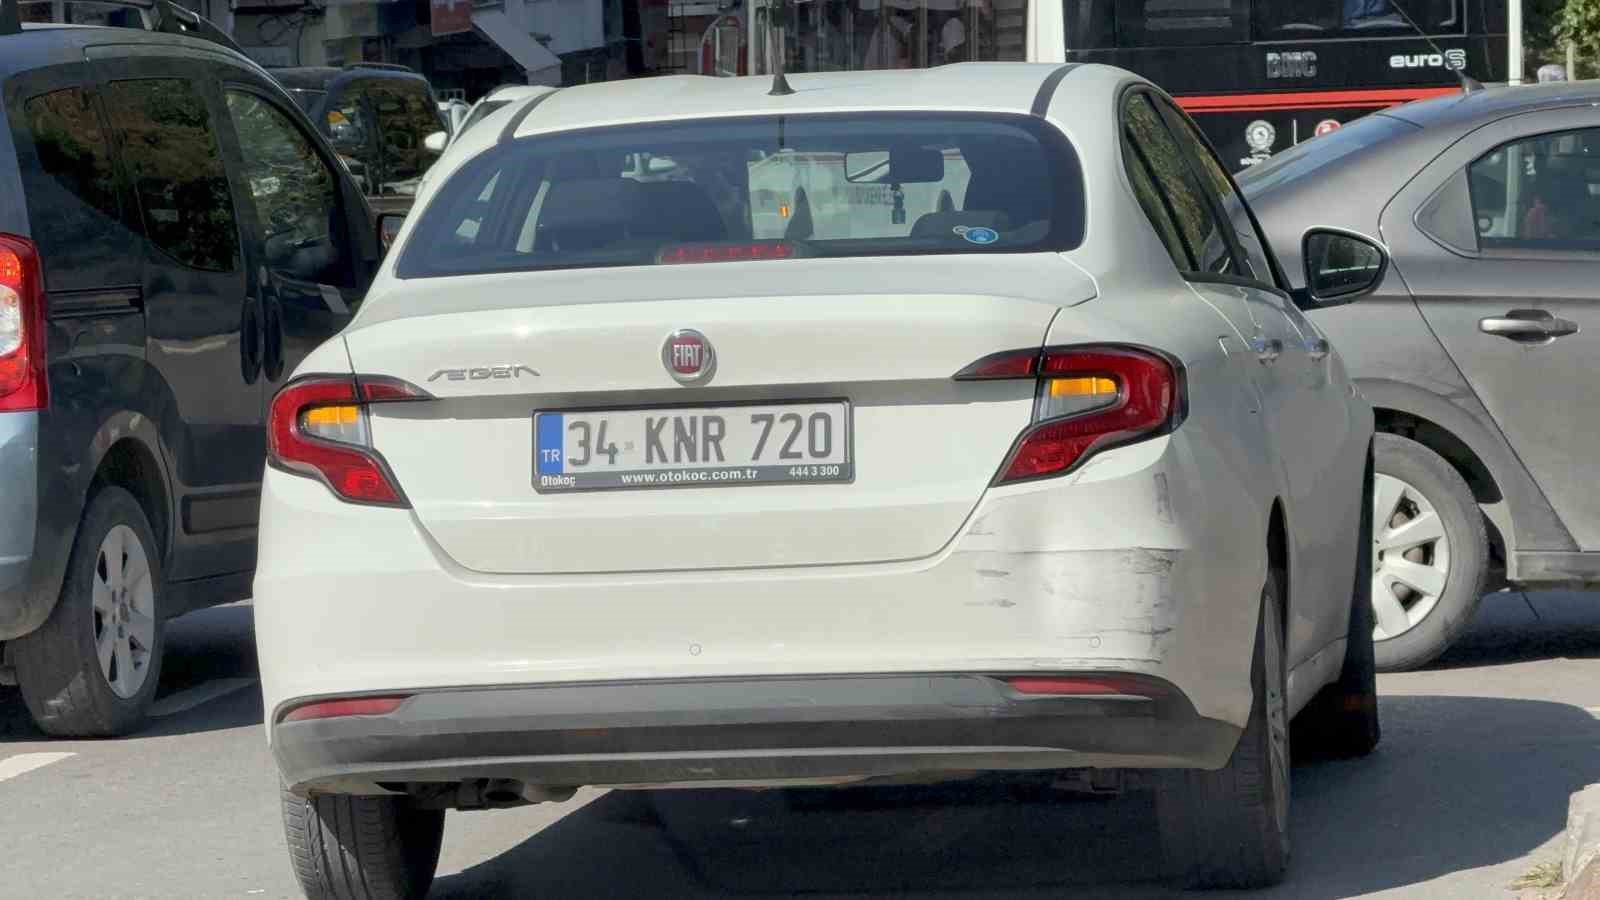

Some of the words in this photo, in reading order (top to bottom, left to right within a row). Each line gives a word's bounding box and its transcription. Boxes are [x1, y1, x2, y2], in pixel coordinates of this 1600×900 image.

[673, 344, 701, 367] FIAT
[568, 420, 618, 466] 34
[645, 415, 725, 464] KNR
[751, 412, 832, 461] 720
[542, 449, 560, 463] TR
[621, 469, 758, 484] www.otokoc.com.tr
[790, 466, 808, 477] 444
[811, 465, 817, 476] 3
[819, 465, 839, 476] 300
